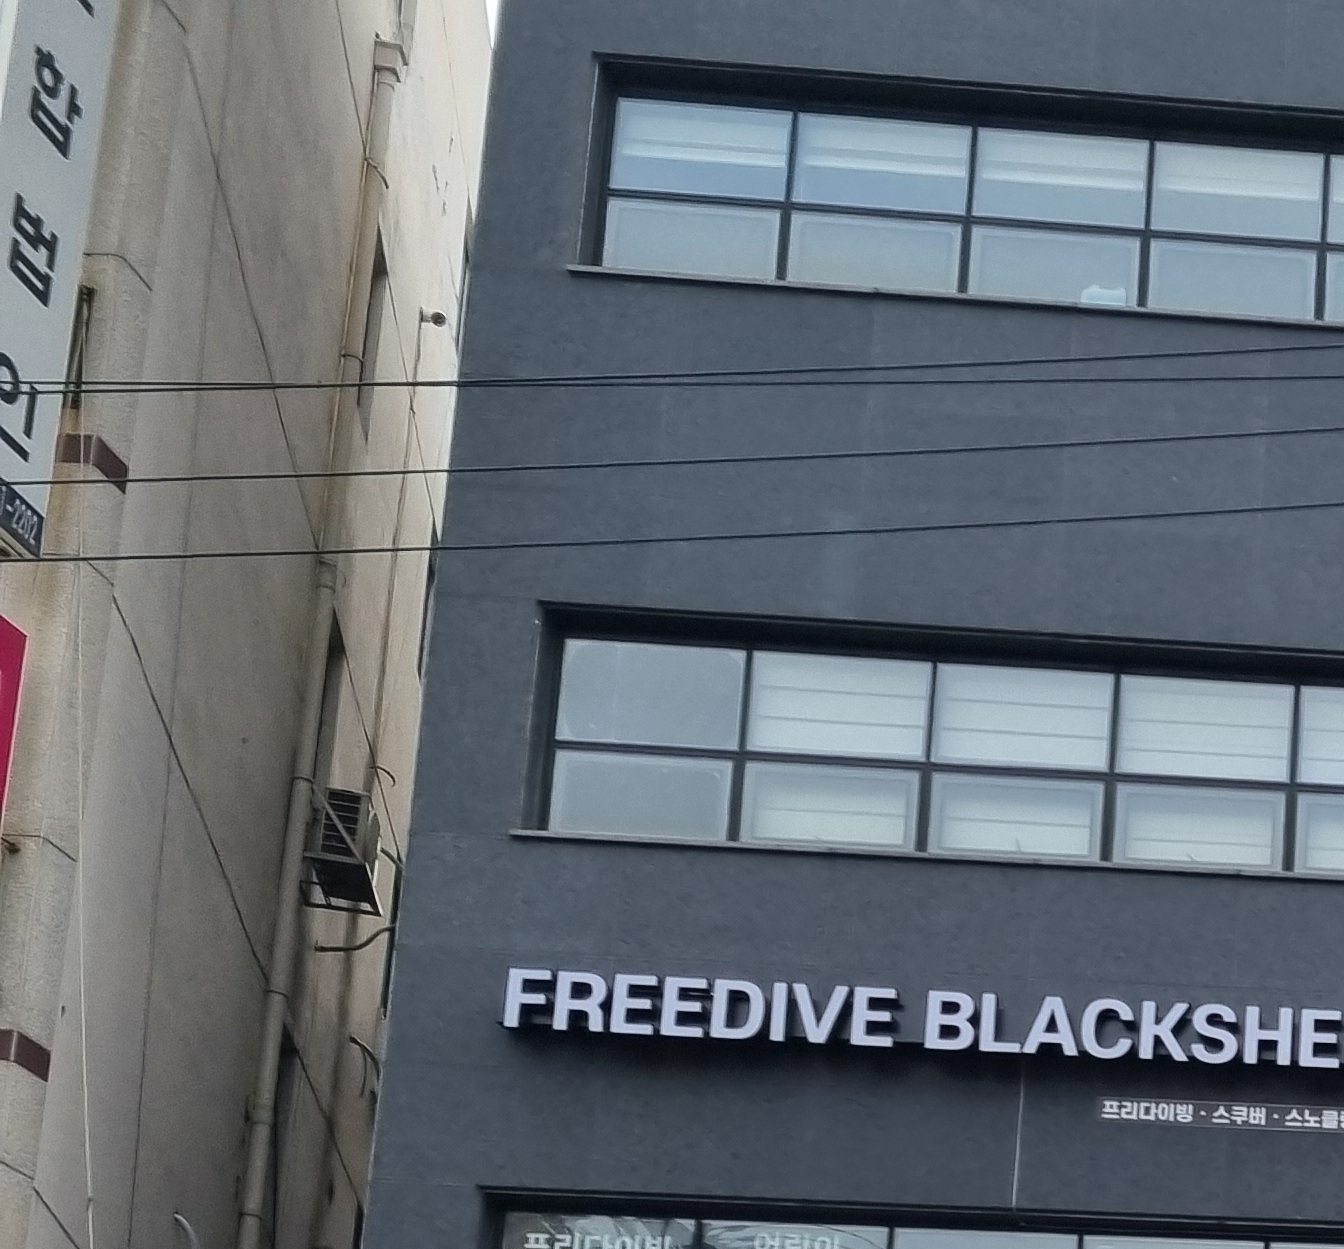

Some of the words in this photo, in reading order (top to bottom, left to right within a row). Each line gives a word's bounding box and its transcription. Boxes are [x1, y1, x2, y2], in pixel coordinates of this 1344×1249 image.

[502, 965, 899, 1047] FREEDIVE
[1101, 1099, 1194, 1123] 프리다이빙
[1211, 1105, 1267, 1126] 스쿠버
